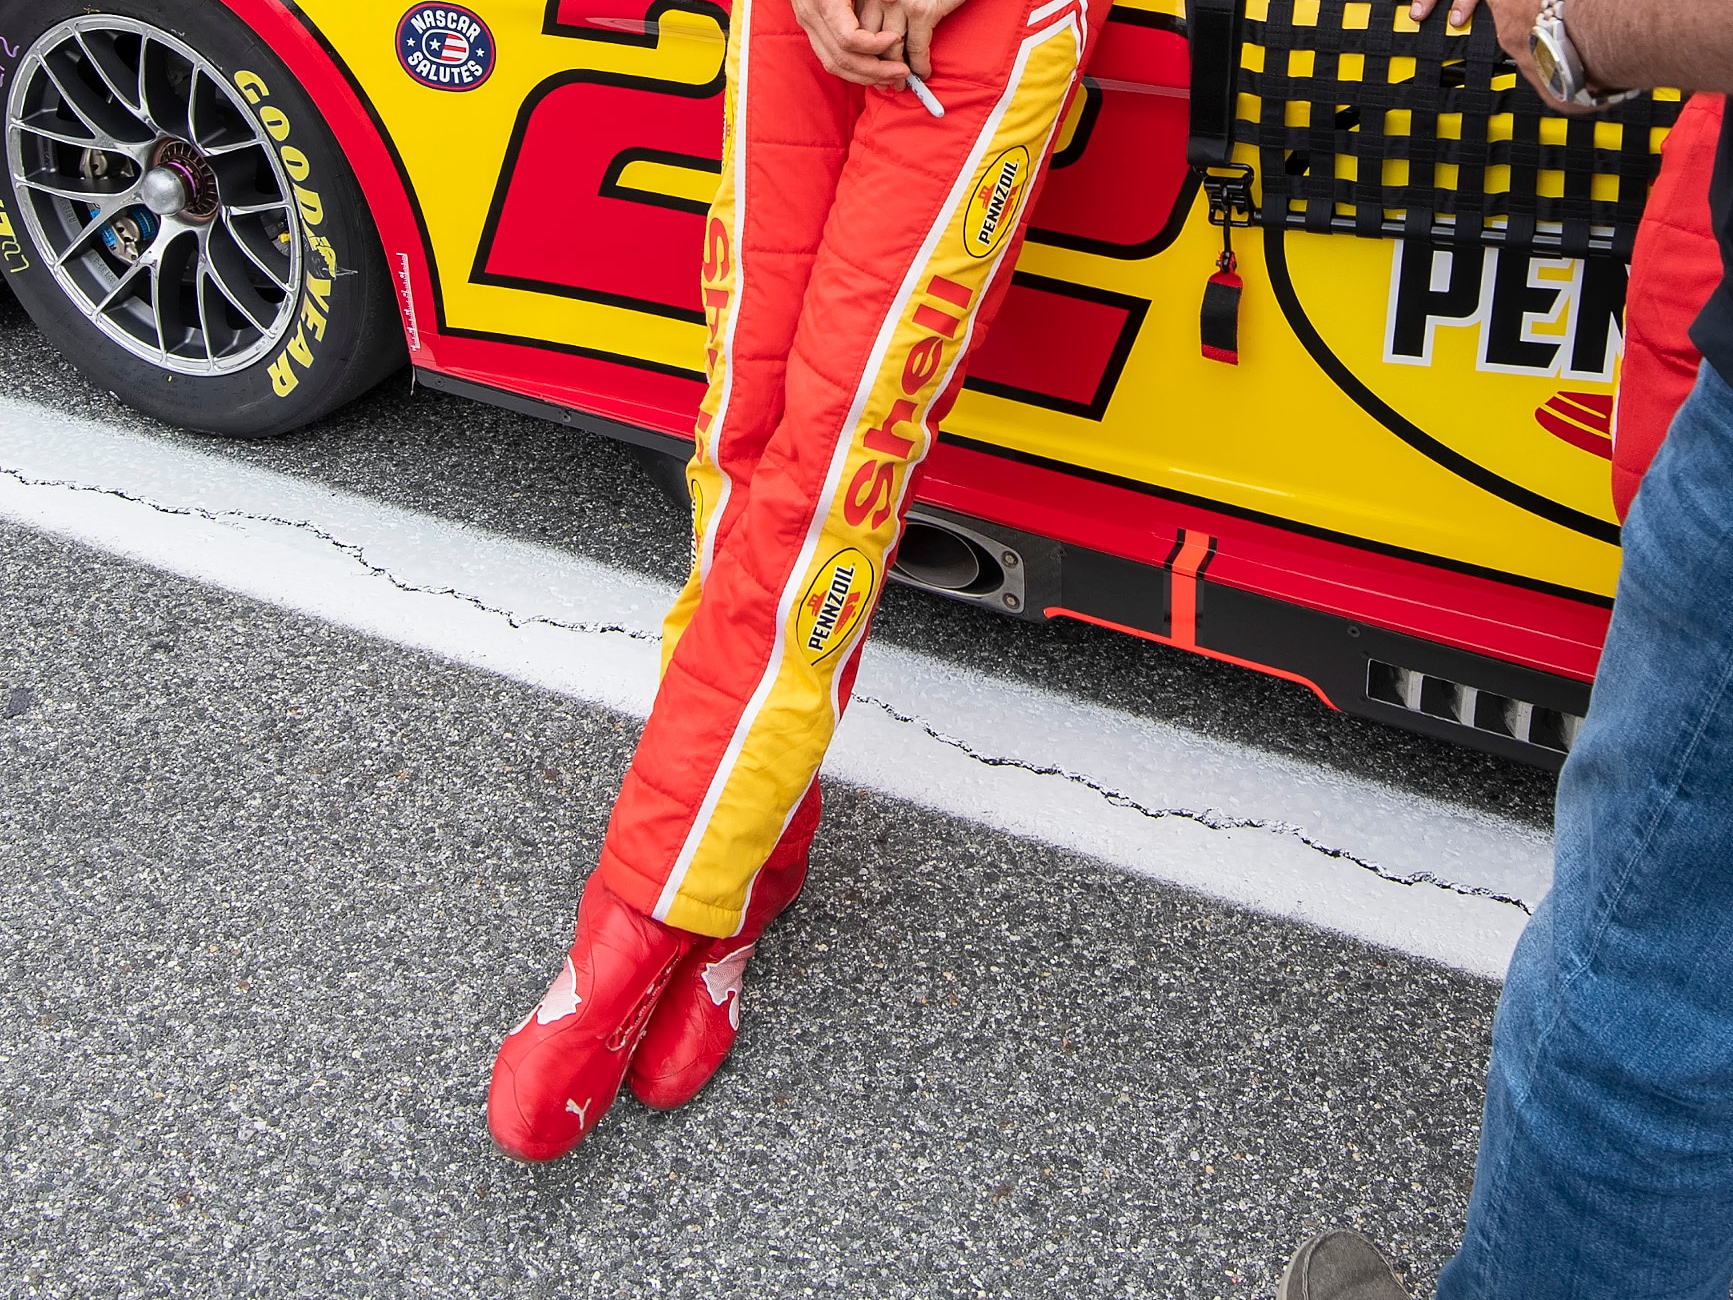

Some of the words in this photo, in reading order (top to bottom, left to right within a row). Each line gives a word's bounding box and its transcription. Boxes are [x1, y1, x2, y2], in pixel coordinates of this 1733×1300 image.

[407, 50, 483, 85] SALUTES
[410, 9, 481, 43] NASCAR
[233, 69, 335, 398] GOODYEAR
[978, 161, 1018, 245] PENNZOIL
[843, 274, 974, 531] Shell
[809, 566, 855, 651] PENNZOIL
